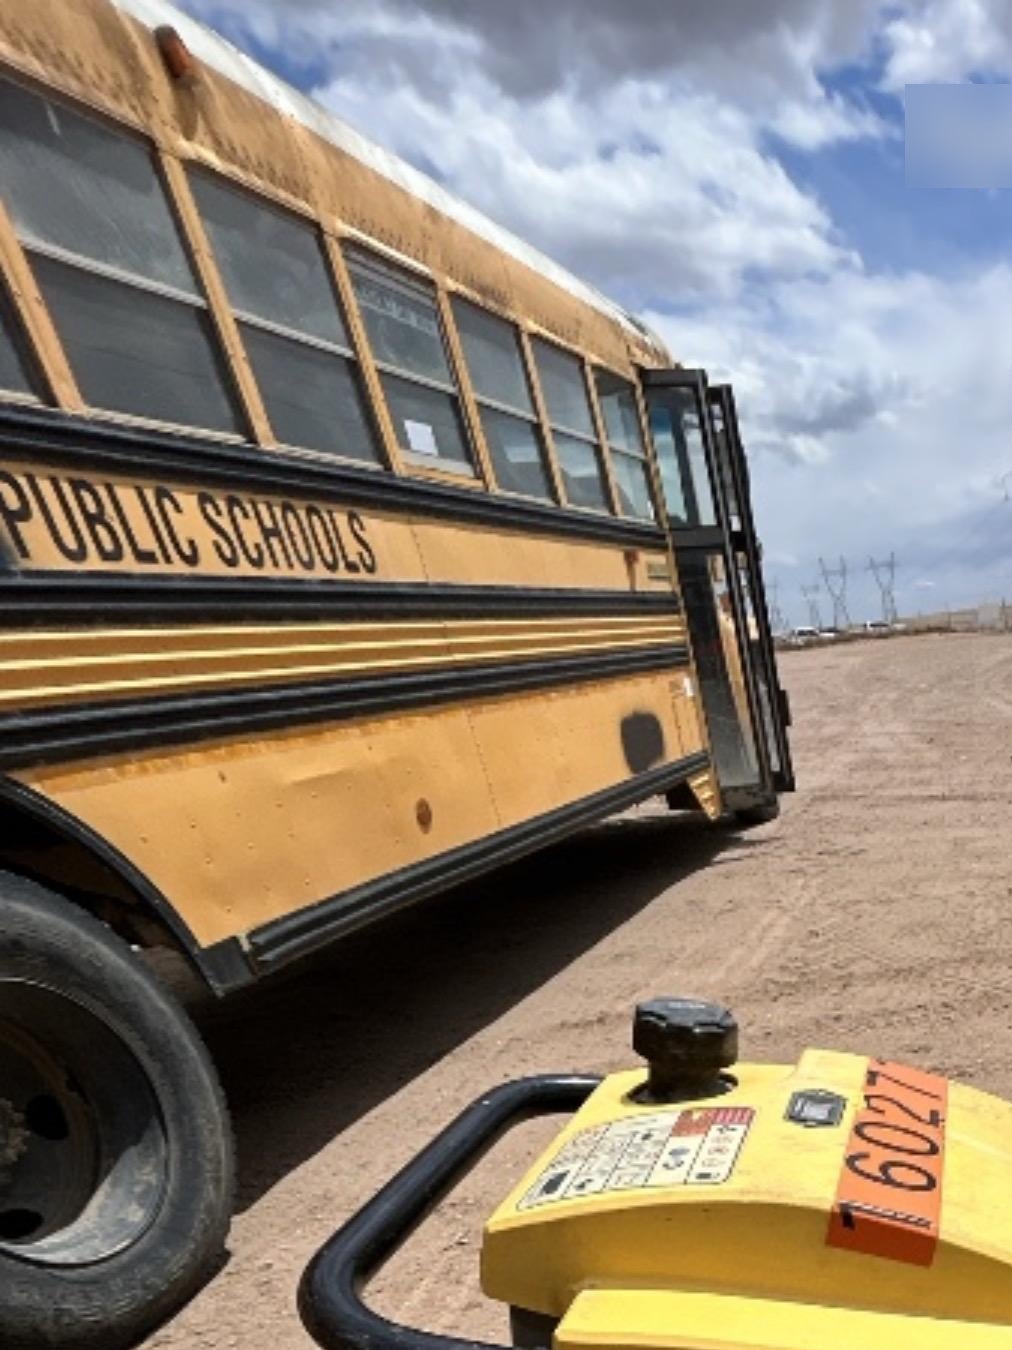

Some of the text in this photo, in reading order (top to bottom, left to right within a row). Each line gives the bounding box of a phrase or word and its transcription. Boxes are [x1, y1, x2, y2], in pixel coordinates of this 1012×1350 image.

[0, 470, 376, 573] PUBLIC SCHOOLS
[839, 1056, 946, 1231] 16027
